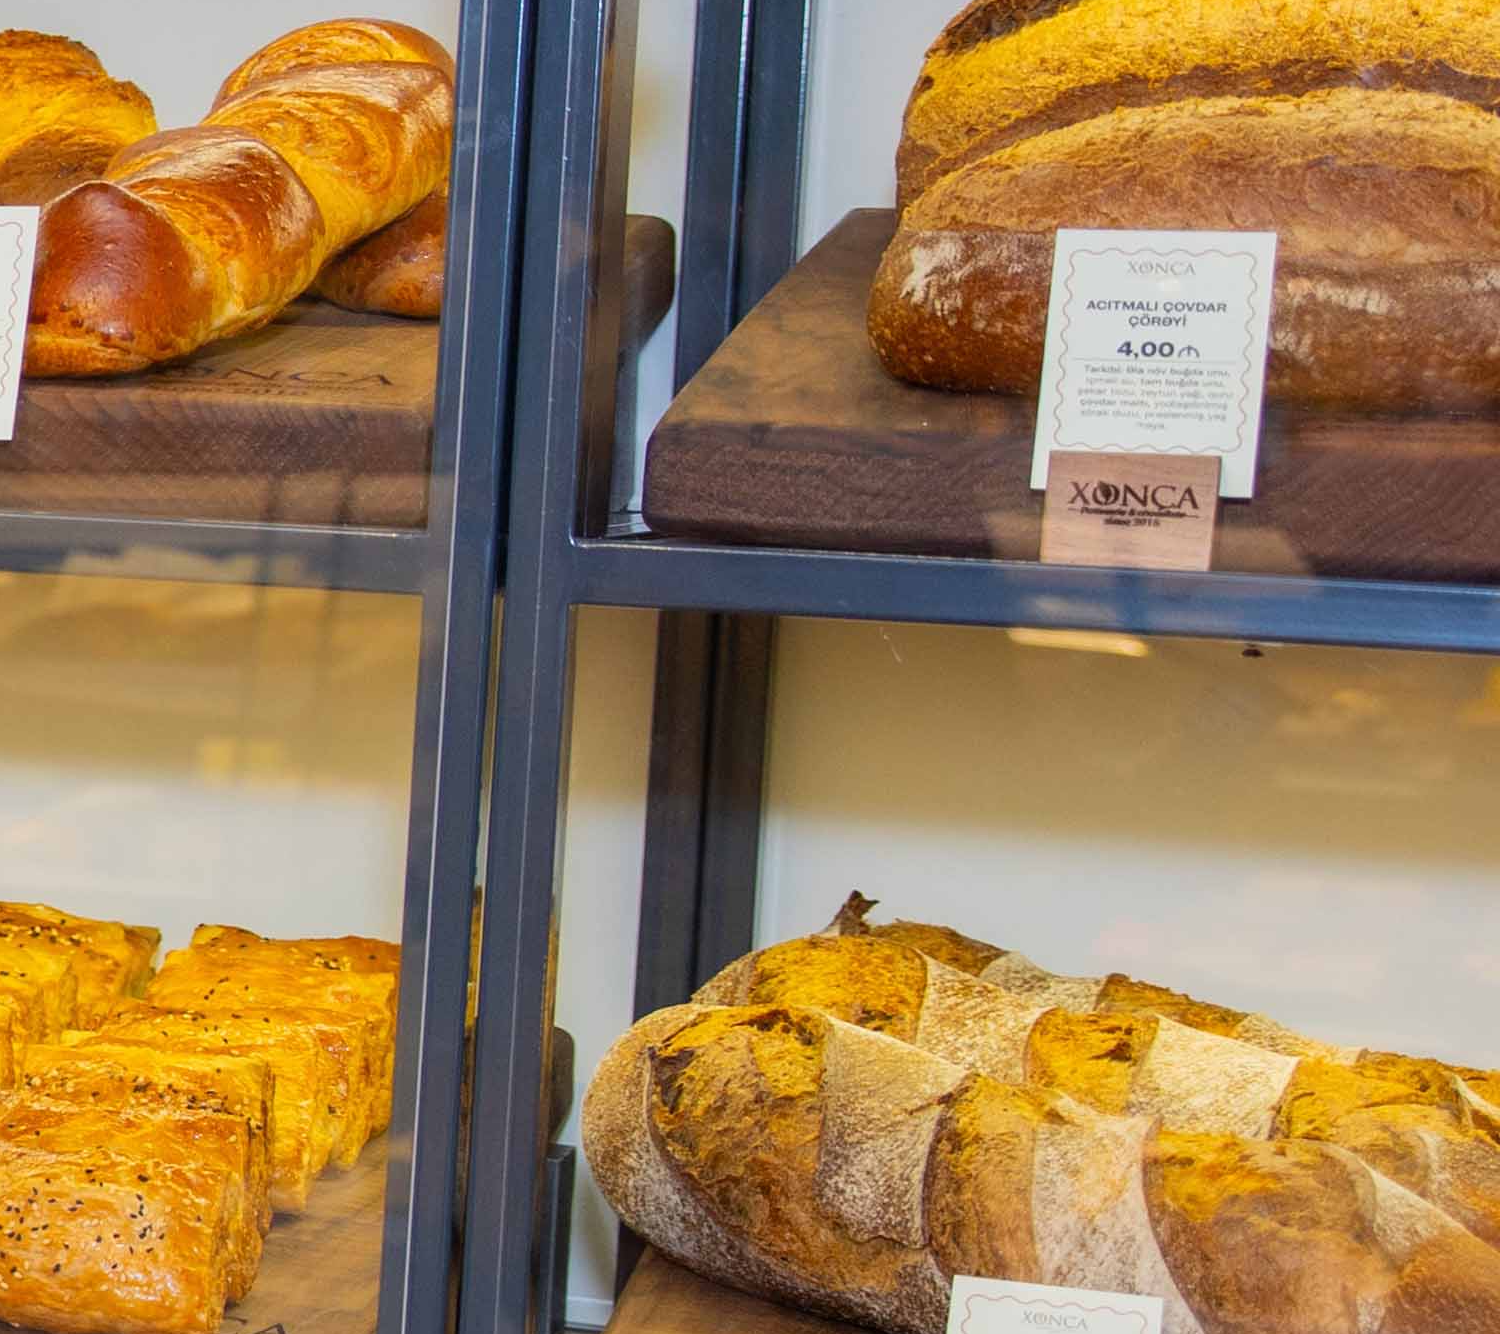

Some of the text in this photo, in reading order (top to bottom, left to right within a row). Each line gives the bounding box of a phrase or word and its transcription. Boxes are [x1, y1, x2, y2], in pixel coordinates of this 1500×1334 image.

[1086, 300, 1227, 314] ACITMALI ÇOVDAR
[1128, 314, 1187, 328] ÇÖRƏYİ
[1117, 341, 1175, 359] 4,00
